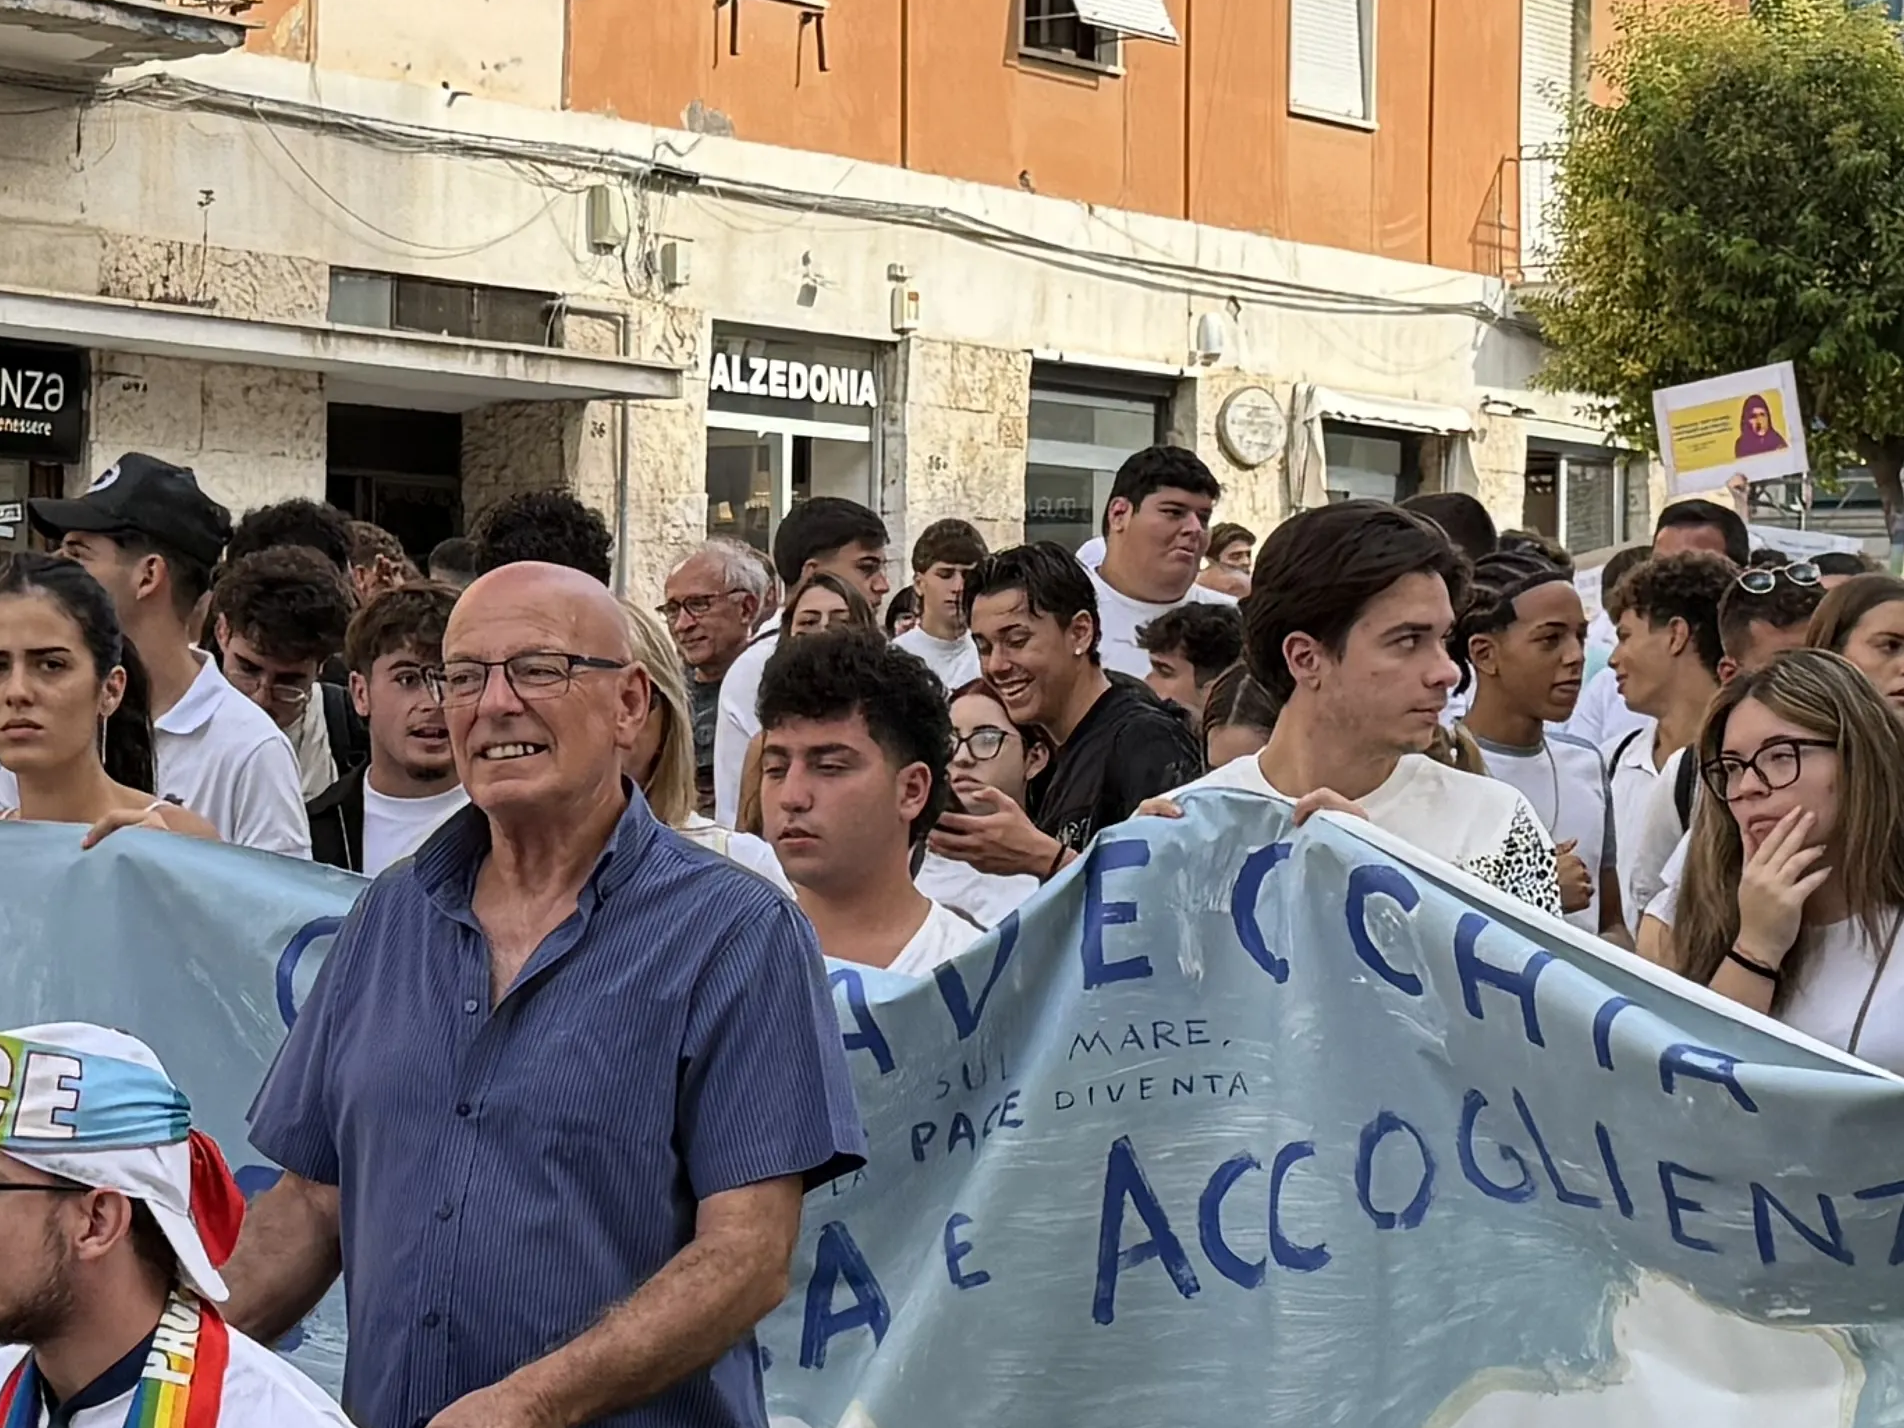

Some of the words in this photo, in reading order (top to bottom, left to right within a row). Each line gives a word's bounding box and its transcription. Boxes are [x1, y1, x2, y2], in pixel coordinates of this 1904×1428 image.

[710, 353, 878, 408] ALZEDONIA
[910, 1088, 1026, 1163] PACE
[1054, 1071, 1250, 1112] DIVENTA
[943, 1211, 991, 1291] E
